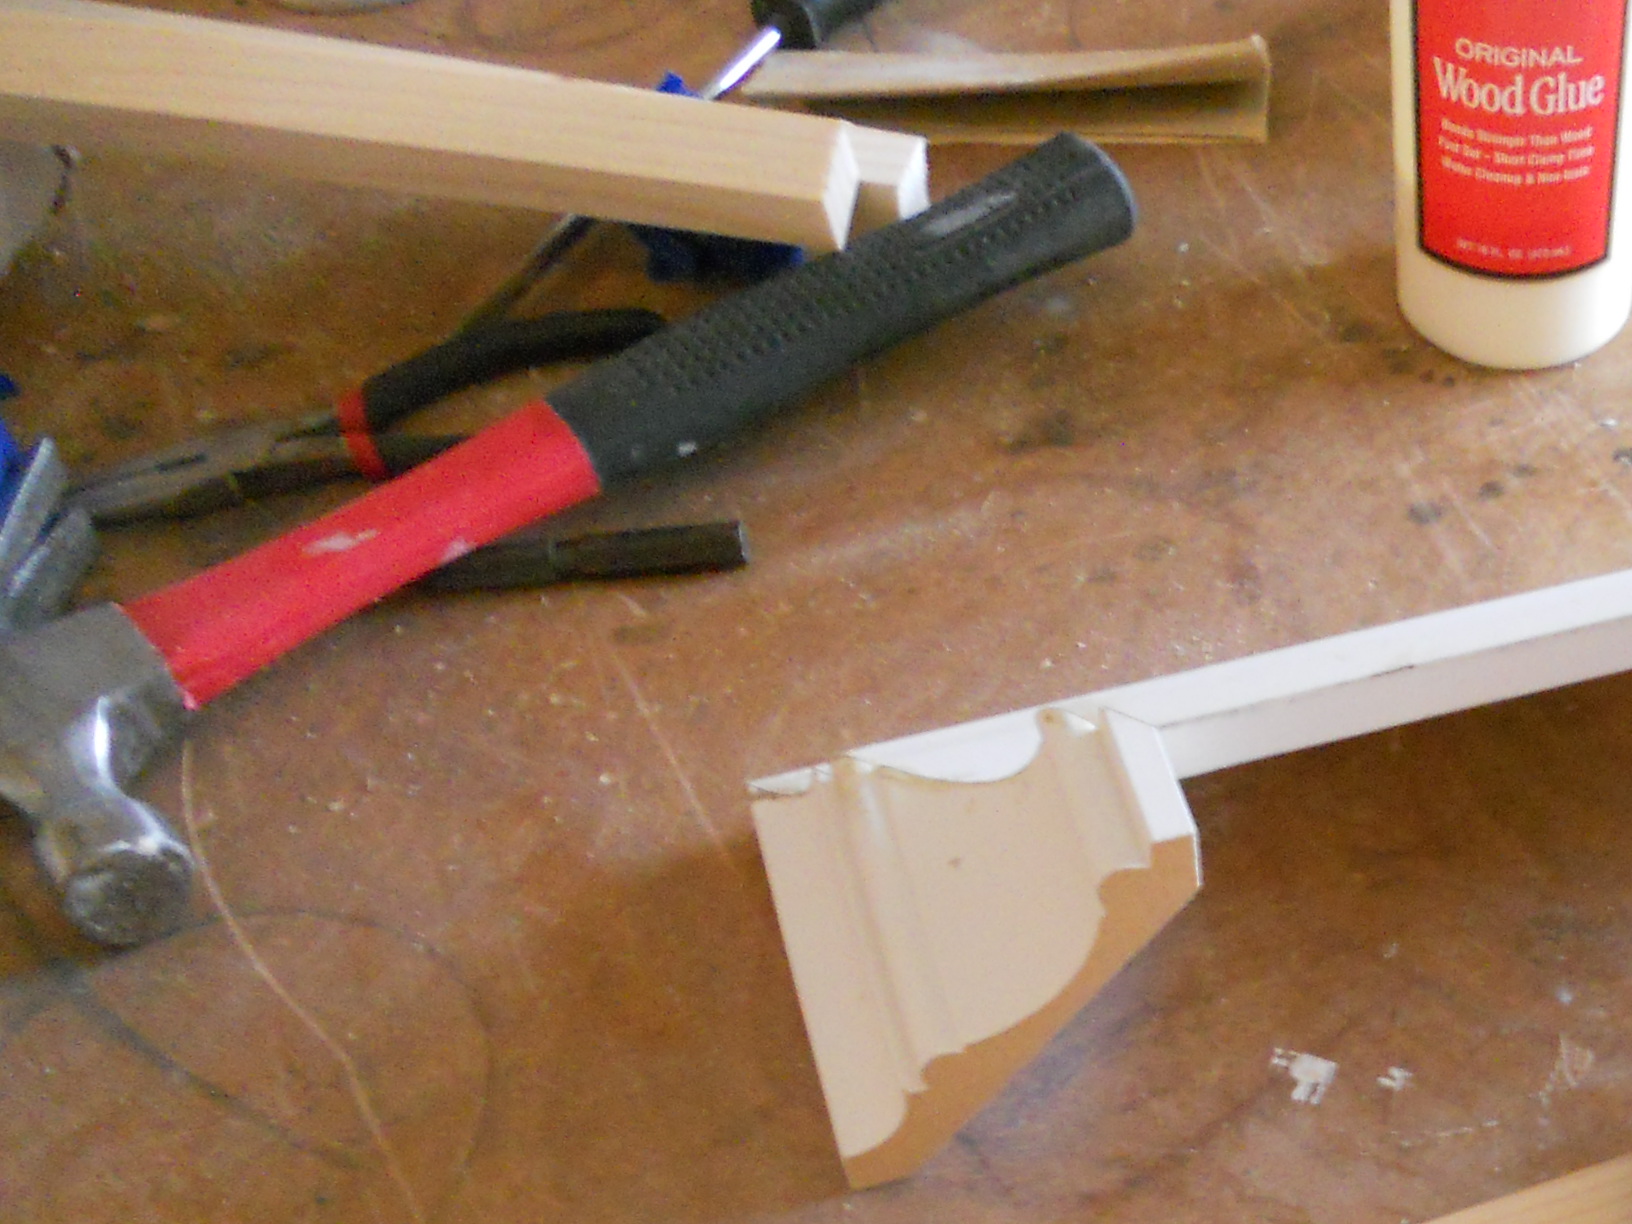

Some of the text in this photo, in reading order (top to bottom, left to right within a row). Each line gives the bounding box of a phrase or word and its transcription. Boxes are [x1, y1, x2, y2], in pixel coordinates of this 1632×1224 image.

[1455, 37, 1583, 68] ORIGINAL
[1433, 56, 1605, 116] Wood Glue
